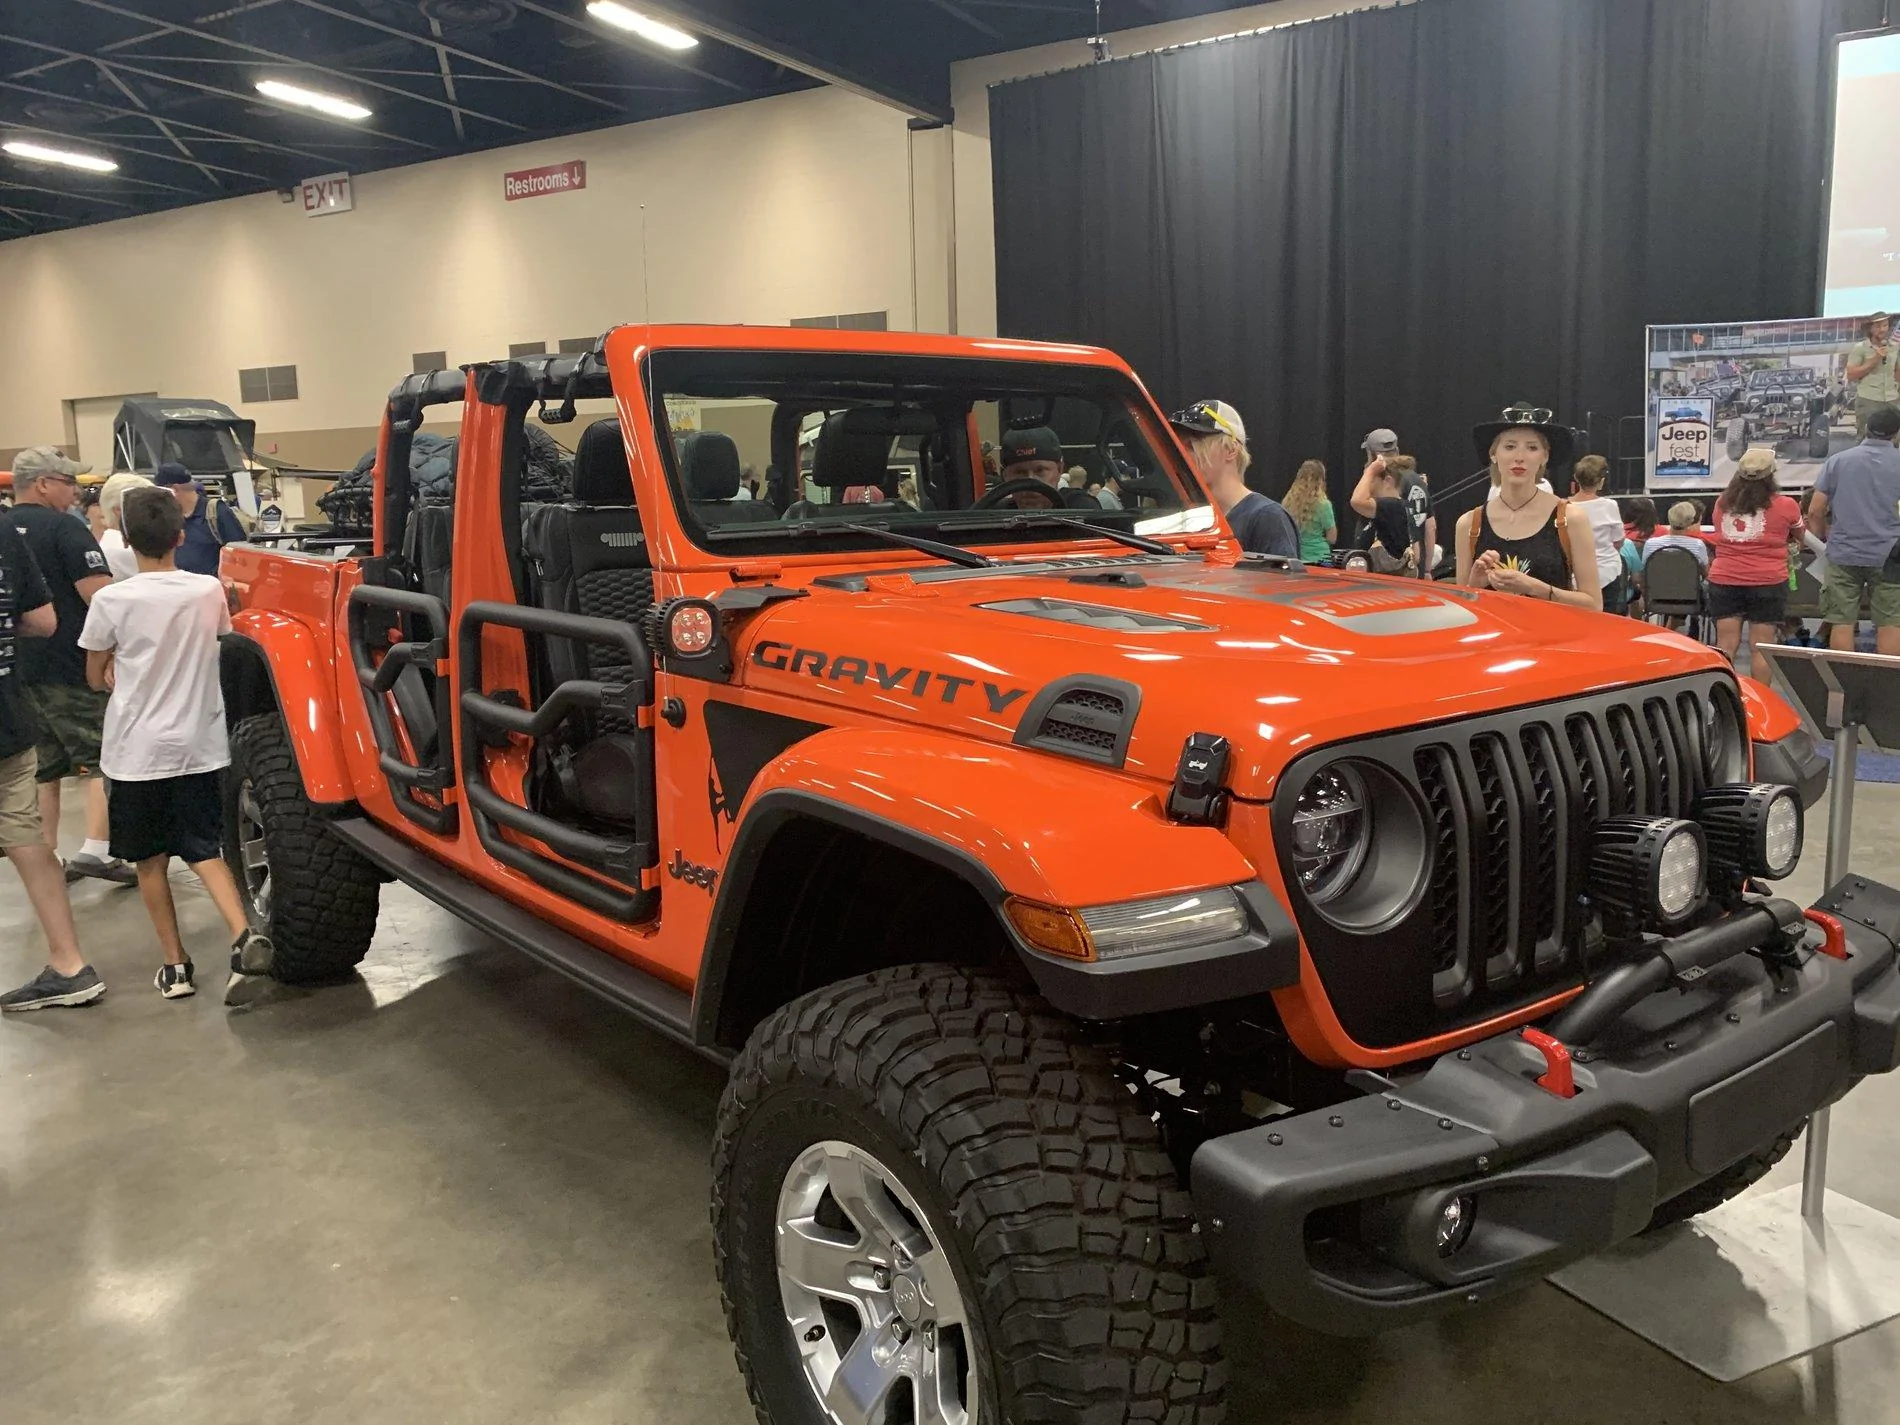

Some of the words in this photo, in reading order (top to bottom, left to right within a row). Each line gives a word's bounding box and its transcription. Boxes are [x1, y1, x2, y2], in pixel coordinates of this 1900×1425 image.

[302, 178, 348, 211] EXIT
[506, 170, 569, 197] Restrooms
[1661, 426, 1708, 443] Jeep
[1669, 443, 1700, 458] fest
[752, 640, 1028, 714] GRAVITY
[667, 848, 719, 898] Jeep
